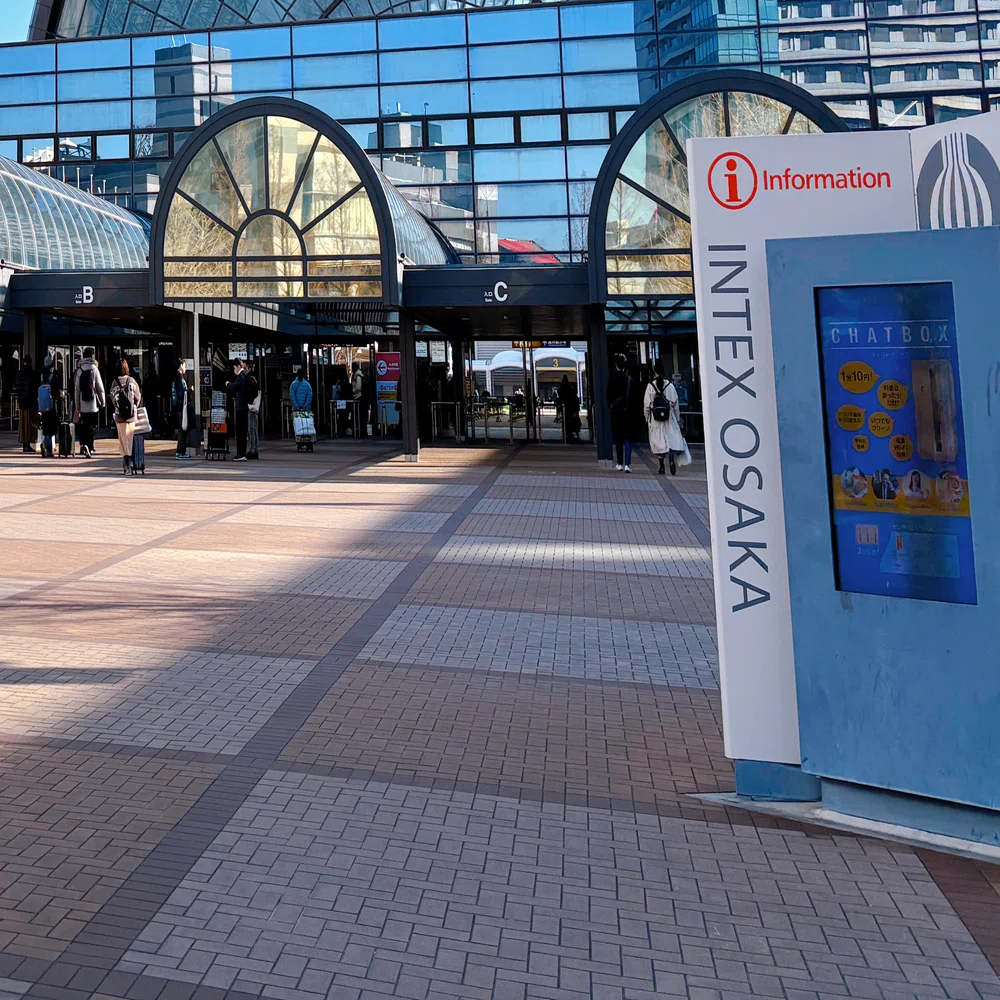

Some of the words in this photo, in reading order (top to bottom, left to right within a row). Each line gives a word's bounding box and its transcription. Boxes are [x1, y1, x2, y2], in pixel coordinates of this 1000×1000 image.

[763, 167, 891, 190] Information
[83, 286, 94, 304] B
[494, 281, 508, 302] C
[708, 245, 756, 399] INTEX
[831, 325, 948, 343] CHATBOX
[553, 358, 559, 367] 3
[720, 418, 770, 613] OSAKA
